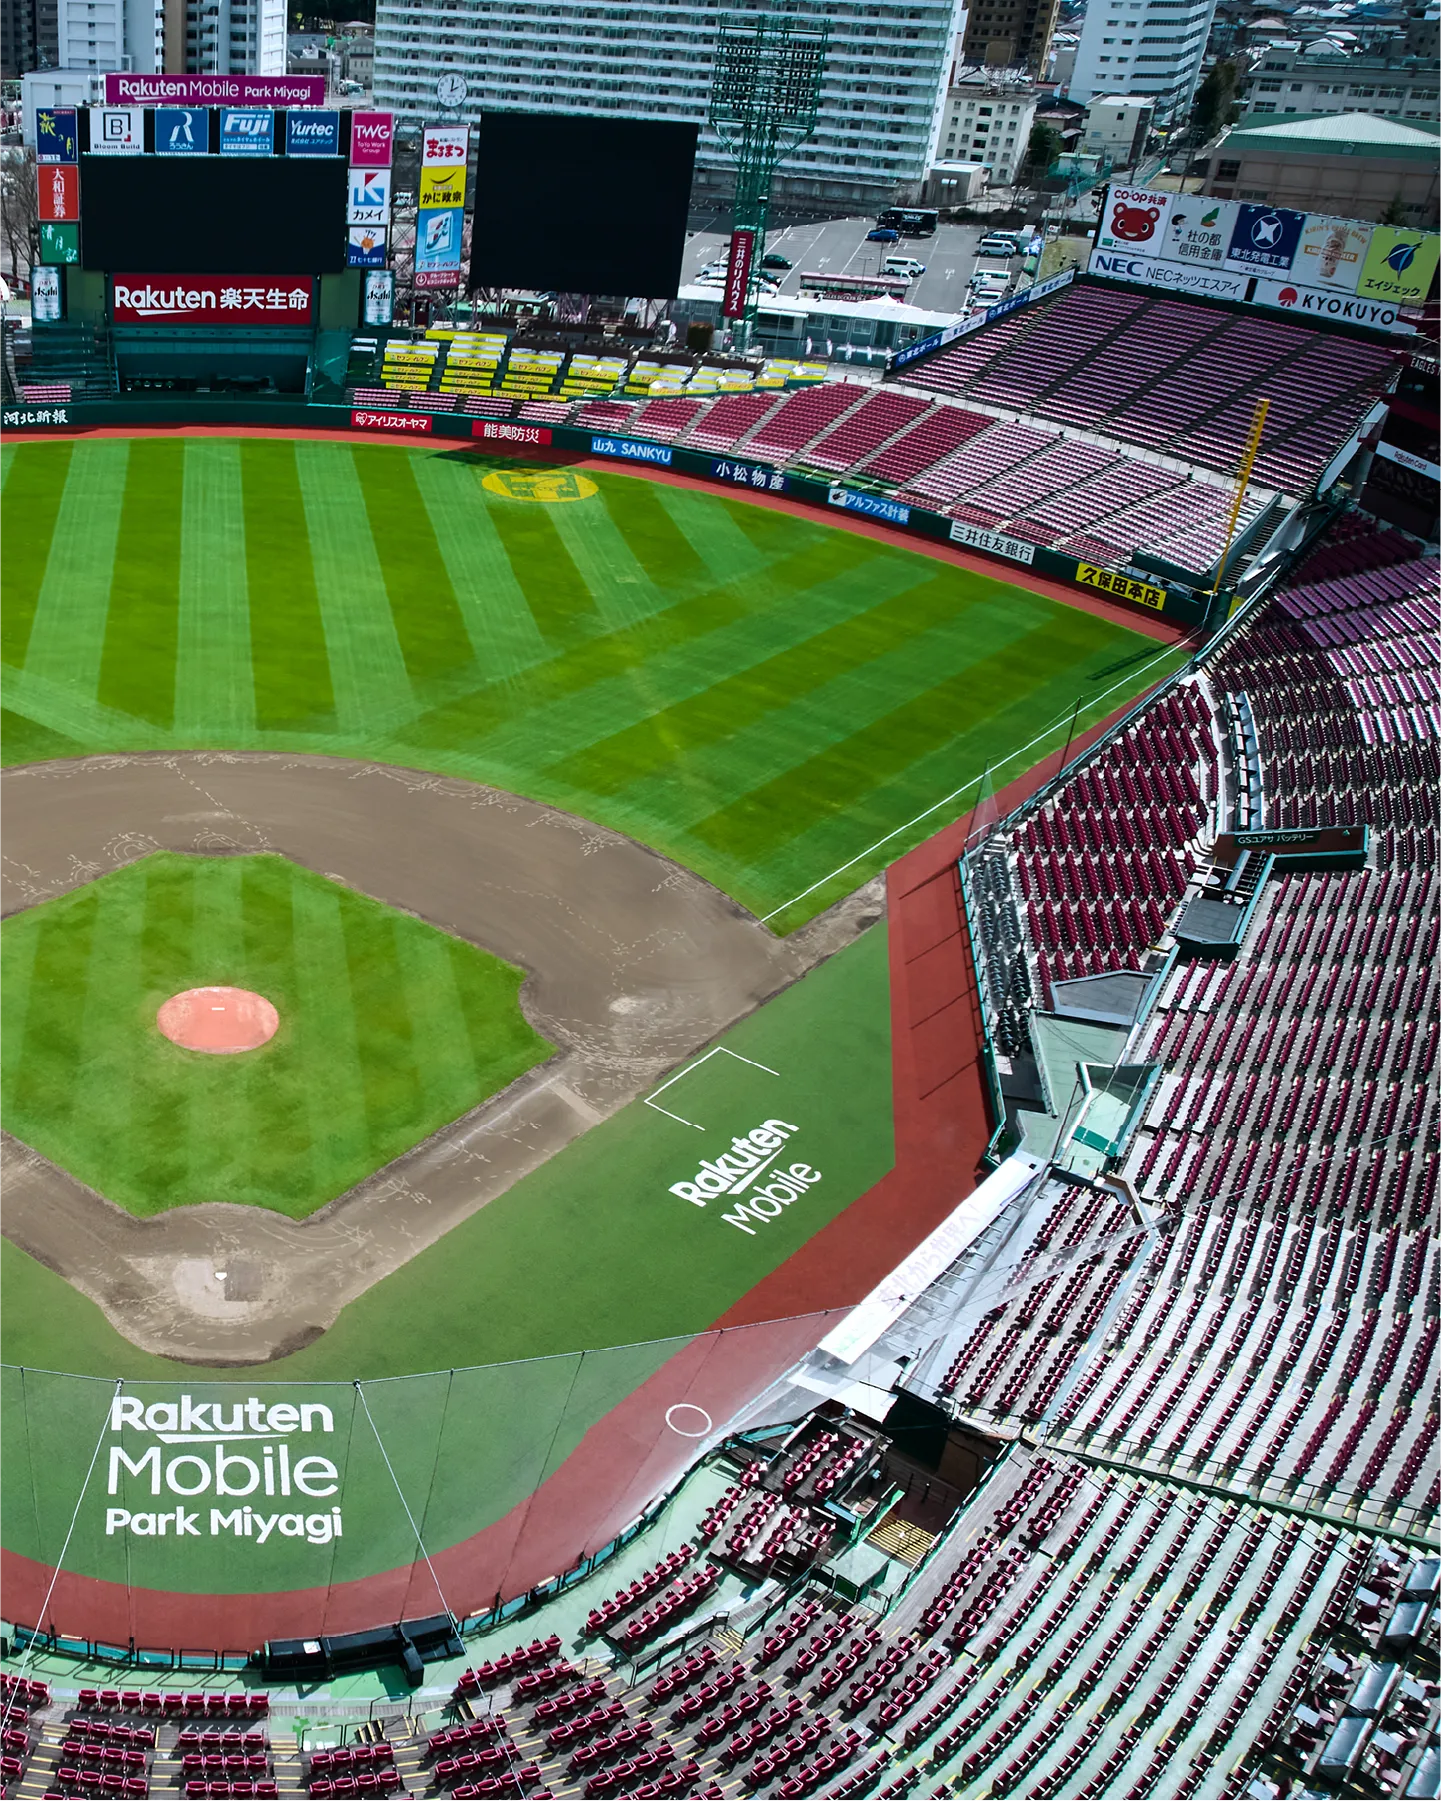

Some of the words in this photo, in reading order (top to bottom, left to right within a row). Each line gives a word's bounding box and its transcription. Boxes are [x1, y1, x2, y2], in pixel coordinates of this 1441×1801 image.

[119, 79, 187, 97] Rakuten
[190, 80, 239, 97] Mobile
[244, 86, 271, 98] Park
[274, 86, 311, 100] Miyagi
[224, 114, 271, 135] Fuji
[291, 120, 333, 136] Yurtec
[354, 124, 390, 140] TWG
[169, 142, 193, 150] ろうきん
[426, 138, 464, 158] まるまつ
[52, 168, 66, 218] 大和証券
[423, 190, 462, 204] かに政宗
[353, 209, 384, 221] カメイ
[1187, 229, 1222, 246] 杜の都
[1178, 242, 1223, 262] 信用金庫
[1230, 247, 1291, 269] 東北発電工業
[729, 237, 747, 312] 三井のリハウス
[1095, 255, 1144, 277] NEC
[1146, 266, 1241, 295] NECネッツエスアイ
[34, 287, 58, 296] Asahi
[114, 285, 216, 309] Rakuten
[220, 288, 310, 310] 楽天生命
[367, 289, 391, 300] Asahi
[1364, 278, 1421, 297] エイジェック
[1302, 294, 1395, 325] KYOKUYO
[1410, 358, 1435, 375] EAGLES
[4, 409, 68, 425] 河北新報
[367, 414, 427, 429] アイリスオーヤマ
[484, 423, 540, 443] 能美防災
[593, 440, 616, 454] 山九
[621, 443, 671, 462] SANKYU
[715, 462, 785, 490] 小松物産
[846, 494, 910, 522] アルファス計装
[952, 525, 1033, 563] 三井住友銀行
[1082, 567, 1161, 607] 久保田本店
[1238, 835, 1274, 845] GSユアサ
[1277, 834, 1314, 843] バッテリー
[668, 1118, 799, 1207] Rakuten
[720, 1162, 822, 1235] Mobile
[110, 1394, 334, 1432] Rakuten
[107, 1444, 339, 1497] Mobile
[105, 1506, 202, 1536] Park
[210, 1506, 343, 1544] Miyagi
